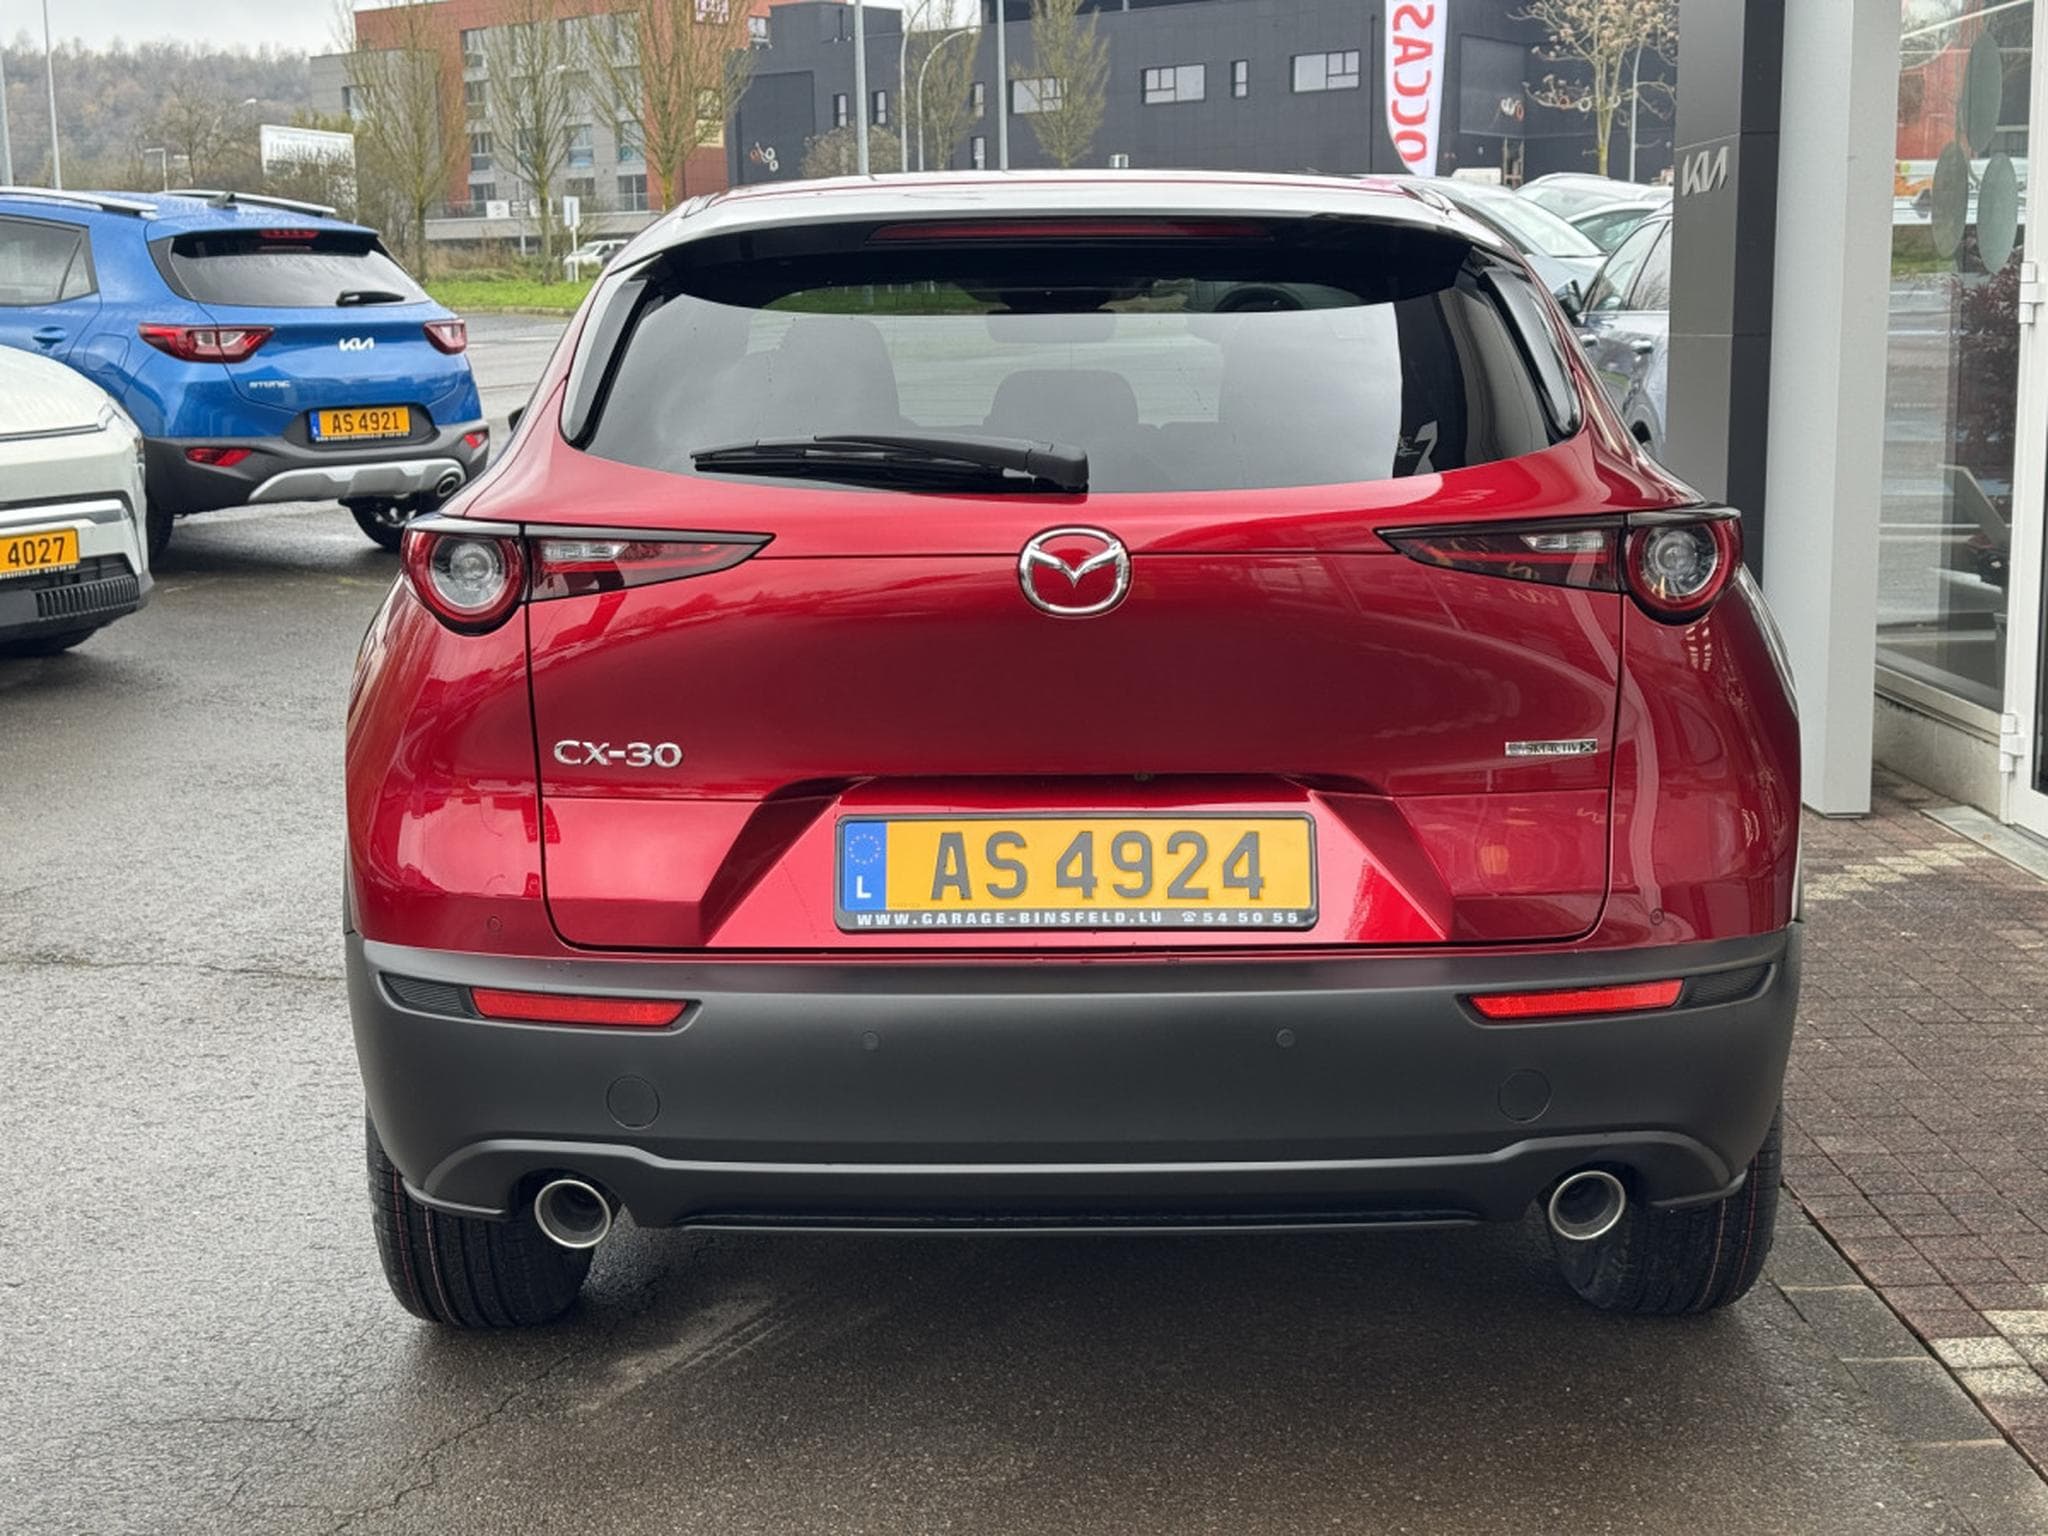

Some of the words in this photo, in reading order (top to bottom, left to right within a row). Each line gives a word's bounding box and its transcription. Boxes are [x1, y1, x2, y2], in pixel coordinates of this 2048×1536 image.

[332, 413, 354, 434] AS
[359, 411, 399, 432] 4921
[8, 536, 65, 567] 4027
[554, 740, 683, 768] CX-30
[931, 831, 1028, 900] AS
[1056, 830, 1264, 900] 4924
[856, 876, 872, 899] L
[857, 911, 1162, 926] WWW.GARAGE-BINSFELD.LU
[1203, 912, 1229, 923] 54
[1238, 912, 1264, 923] 50
[1273, 912, 1298, 923] 55
